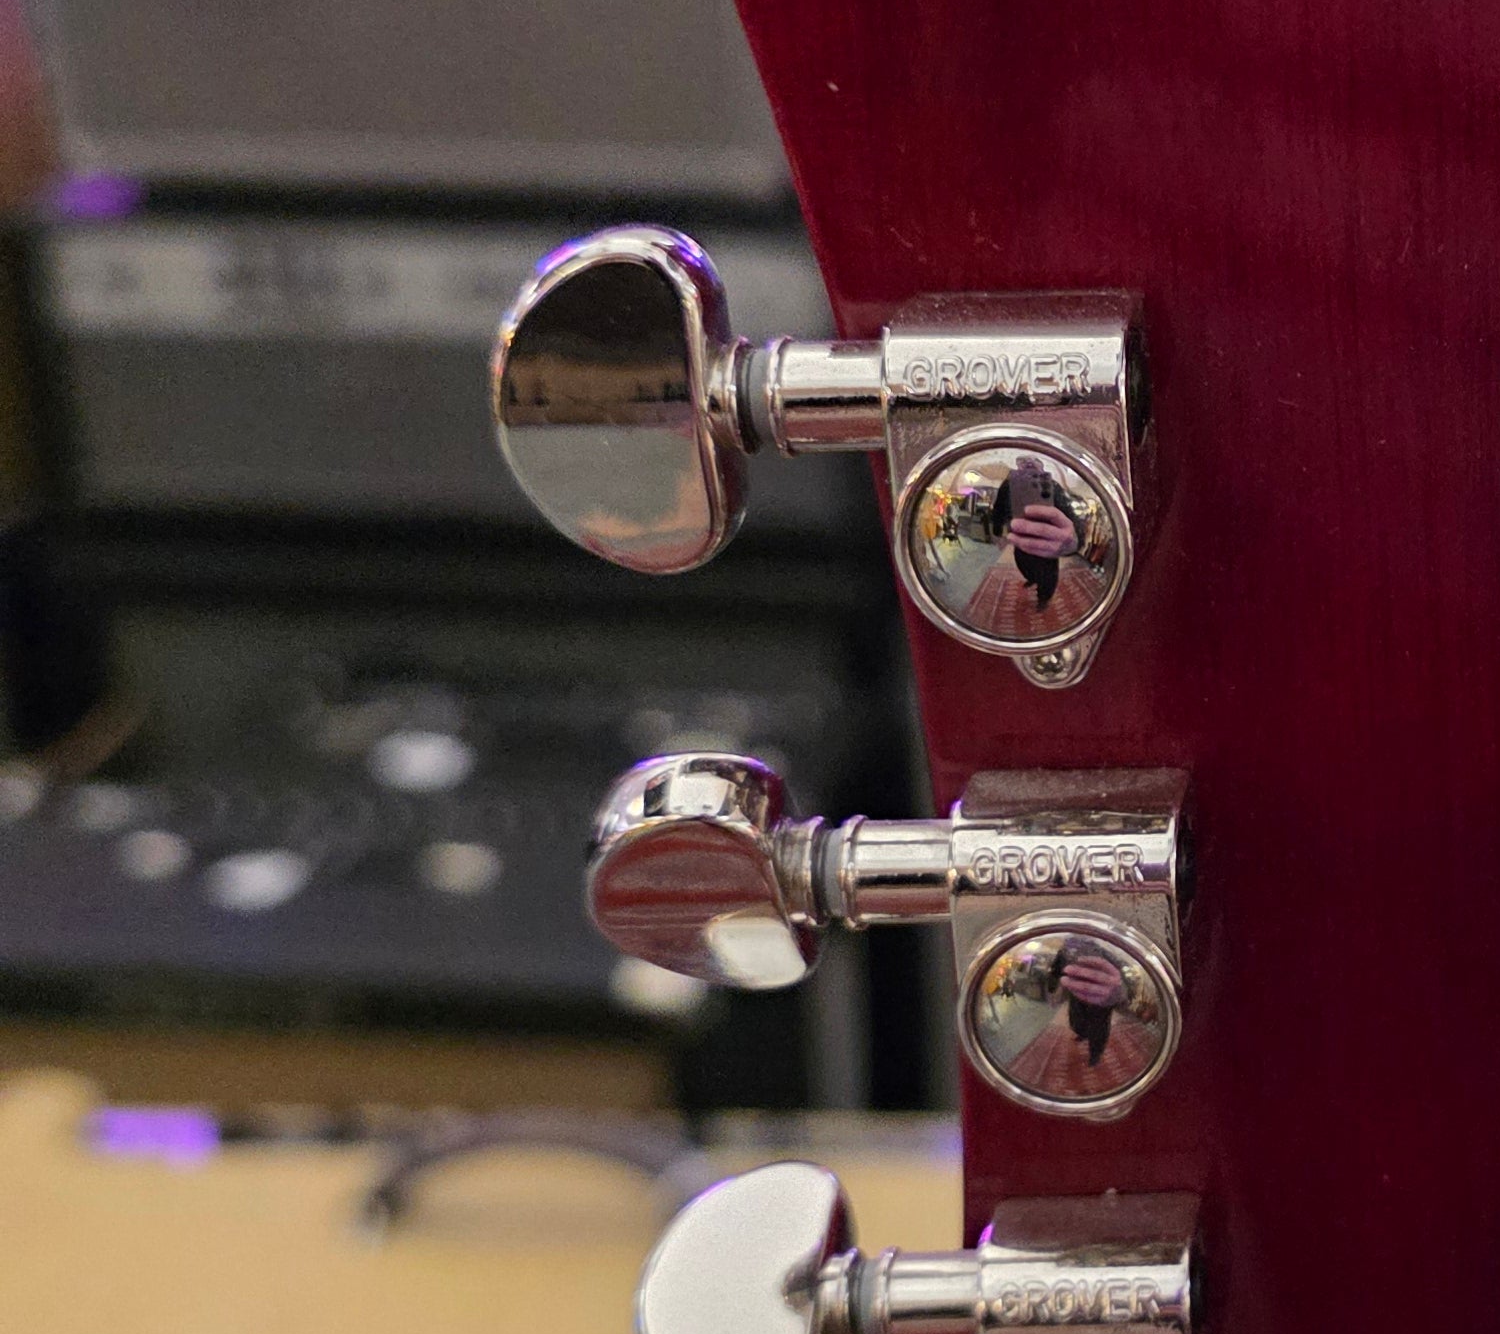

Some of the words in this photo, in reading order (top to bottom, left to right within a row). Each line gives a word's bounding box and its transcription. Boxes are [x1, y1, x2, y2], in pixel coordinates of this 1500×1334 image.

[903, 352, 1092, 403] GROVER
[969, 844, 1145, 890] GROVER
[999, 1277, 1161, 1323] GROVER
